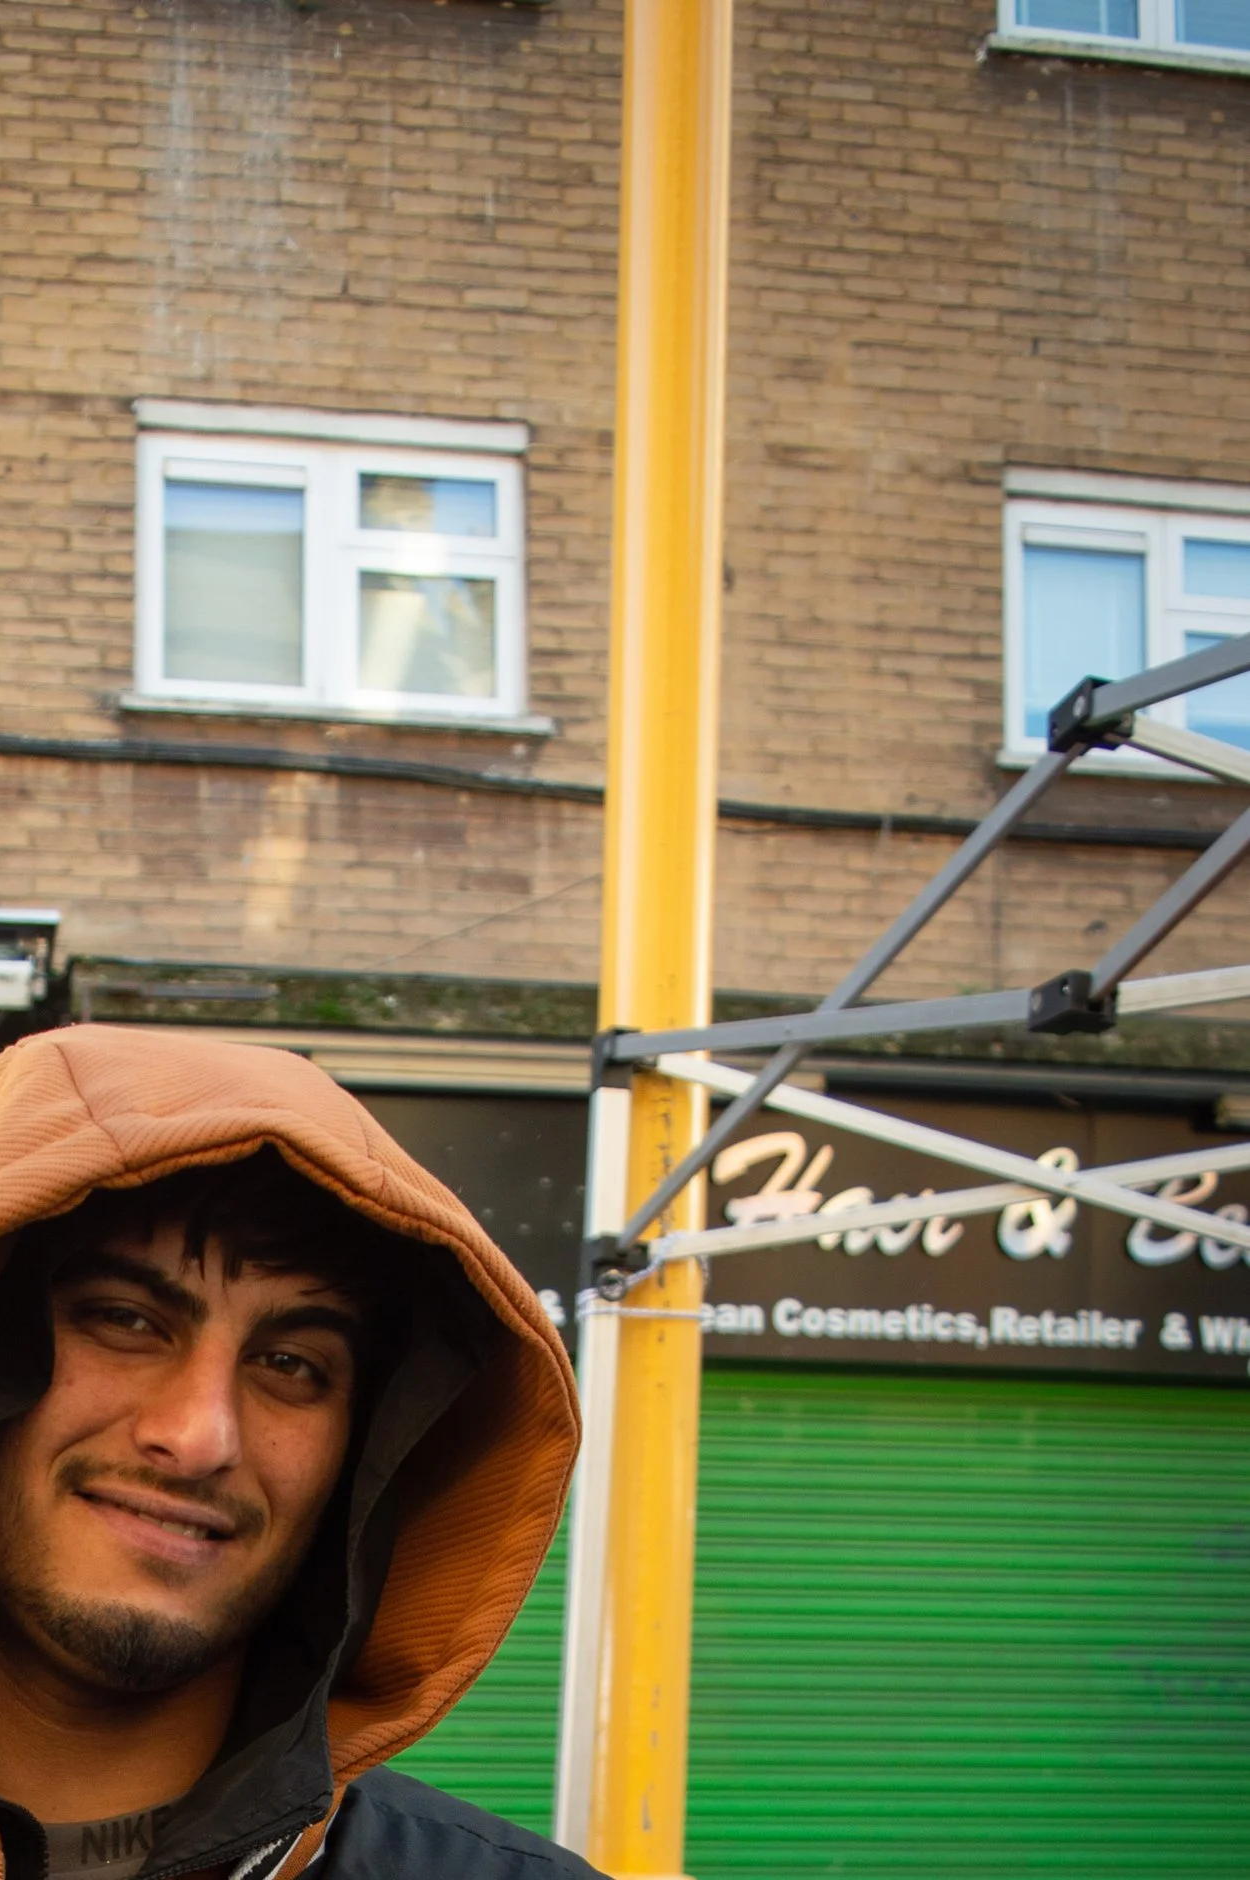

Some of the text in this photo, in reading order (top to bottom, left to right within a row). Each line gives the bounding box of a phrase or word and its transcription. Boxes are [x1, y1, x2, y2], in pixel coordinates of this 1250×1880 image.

[999, 1147, 1079, 1259] &
[990, 1306, 1143, 1349] Retailer
[1159, 1312, 1193, 1351] &
